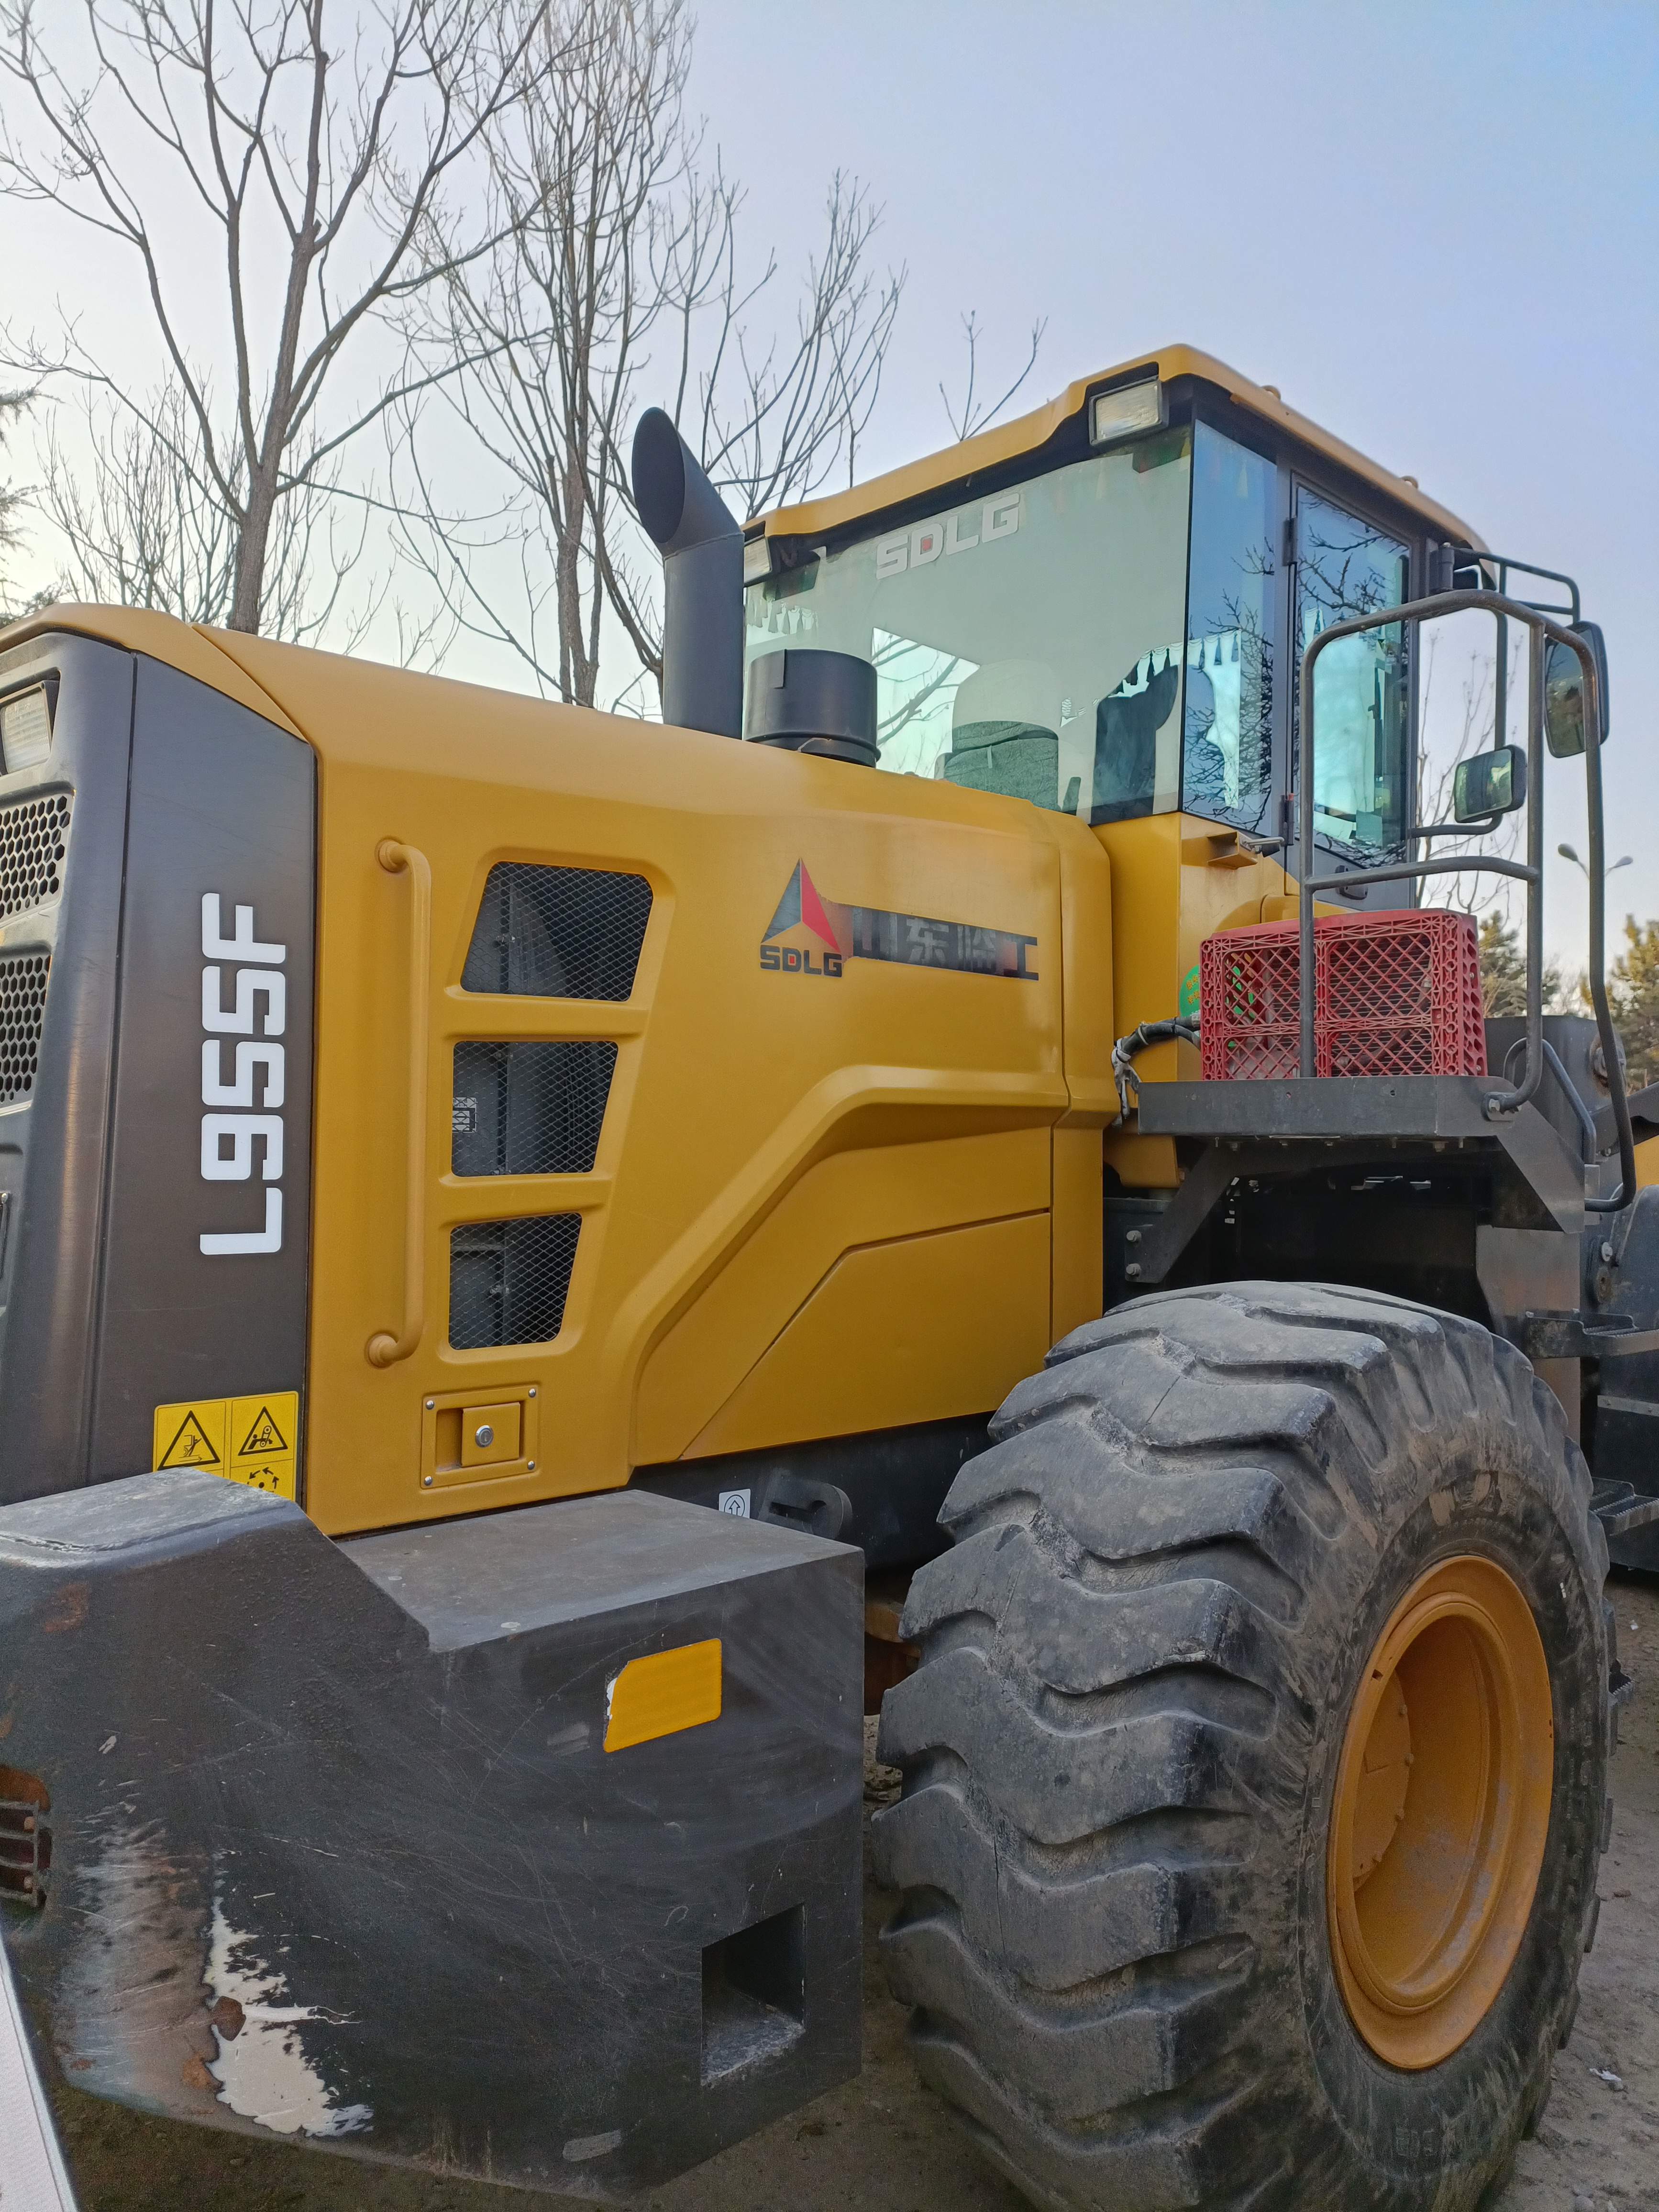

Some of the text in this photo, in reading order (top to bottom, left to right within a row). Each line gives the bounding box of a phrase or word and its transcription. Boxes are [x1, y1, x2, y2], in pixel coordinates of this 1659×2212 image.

[876, 493, 1020, 580] SDLG
[760, 944, 842, 977] SDLG
[199, 893, 286, 1255] L955F
